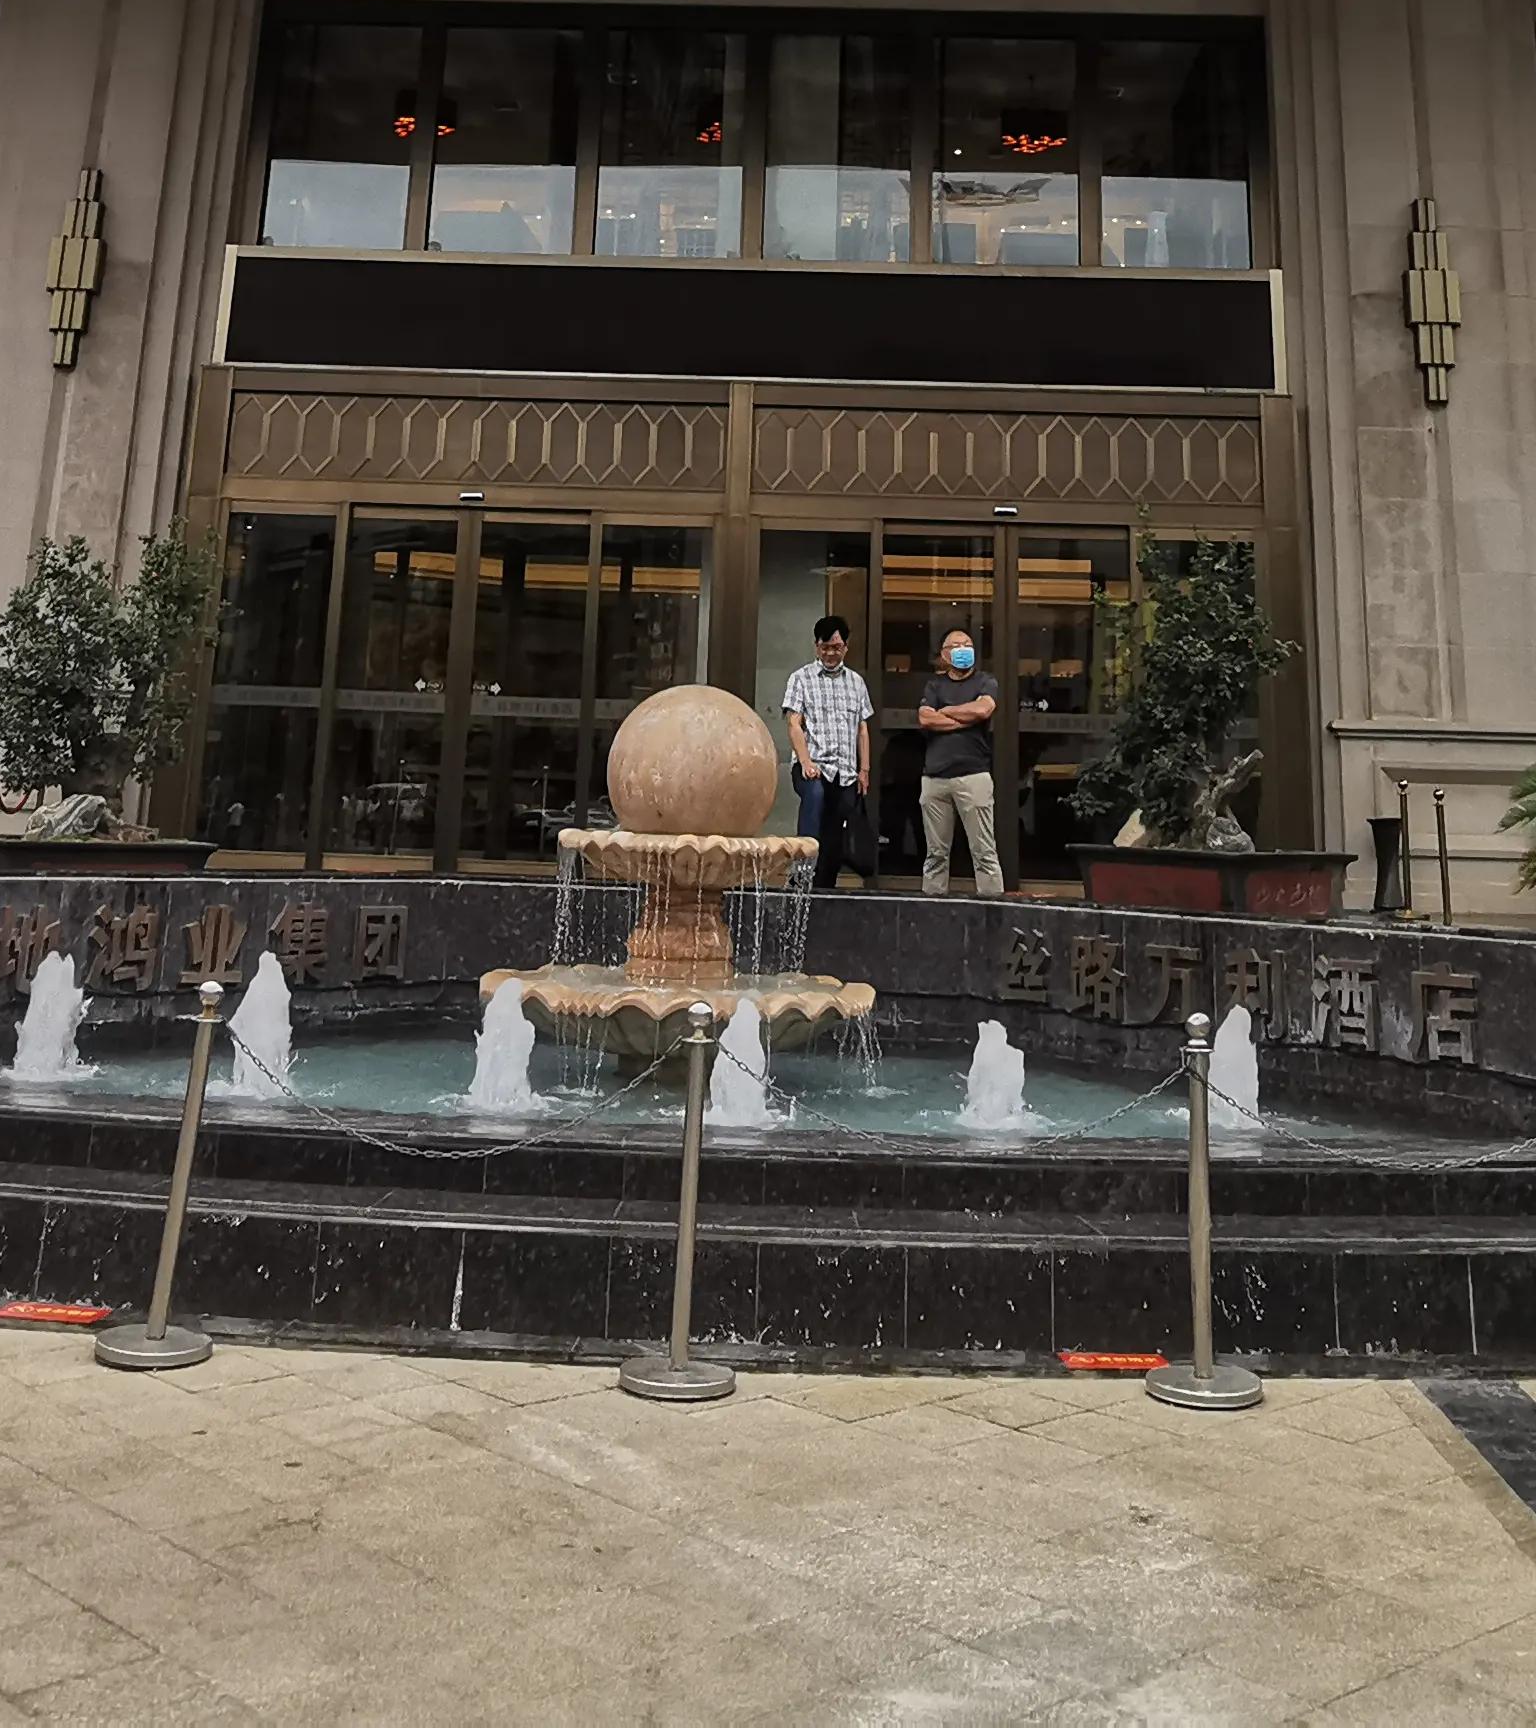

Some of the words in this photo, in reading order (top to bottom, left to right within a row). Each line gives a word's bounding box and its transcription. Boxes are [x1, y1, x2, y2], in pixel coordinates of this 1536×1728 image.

[1000, 925, 1480, 1065] 丝路万利酒店
